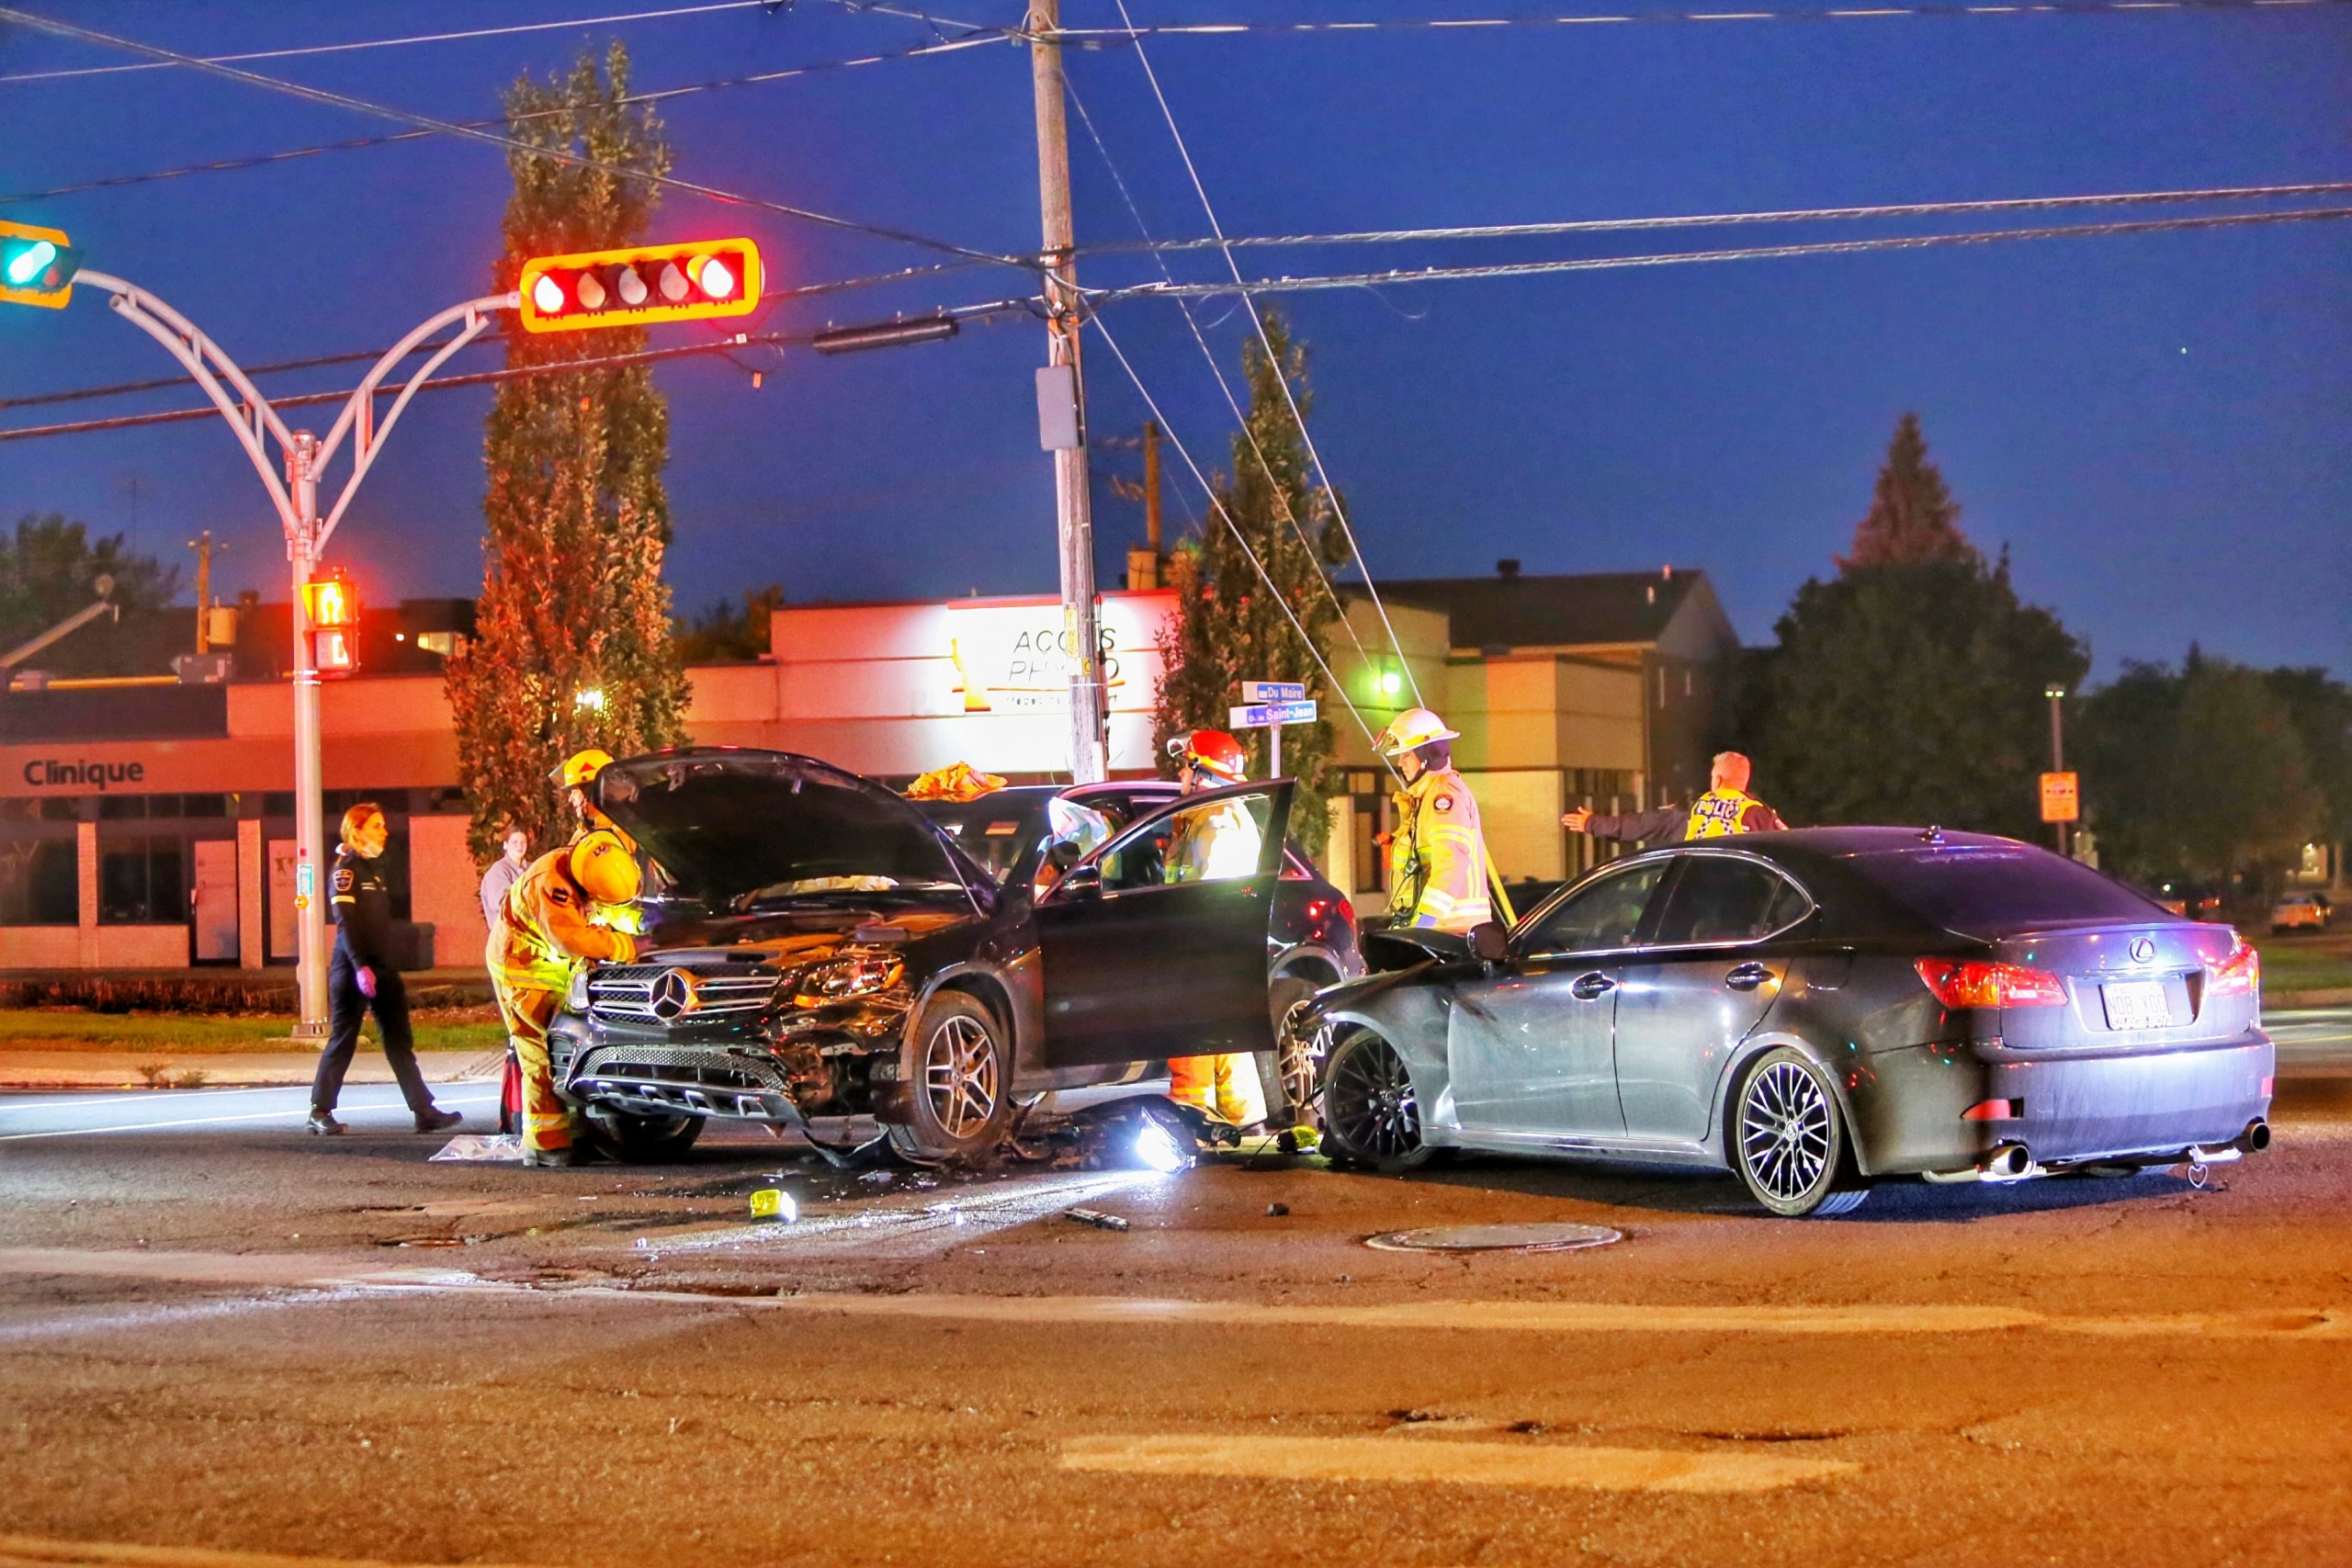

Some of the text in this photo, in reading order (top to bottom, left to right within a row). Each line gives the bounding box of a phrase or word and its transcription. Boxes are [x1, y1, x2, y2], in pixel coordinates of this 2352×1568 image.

[1268, 686, 1279, 697] Du
[1281, 687, 1302, 698] Maire
[1266, 706, 1313, 720] Saint-Jean
[24, 759, 144, 791] Clinique
